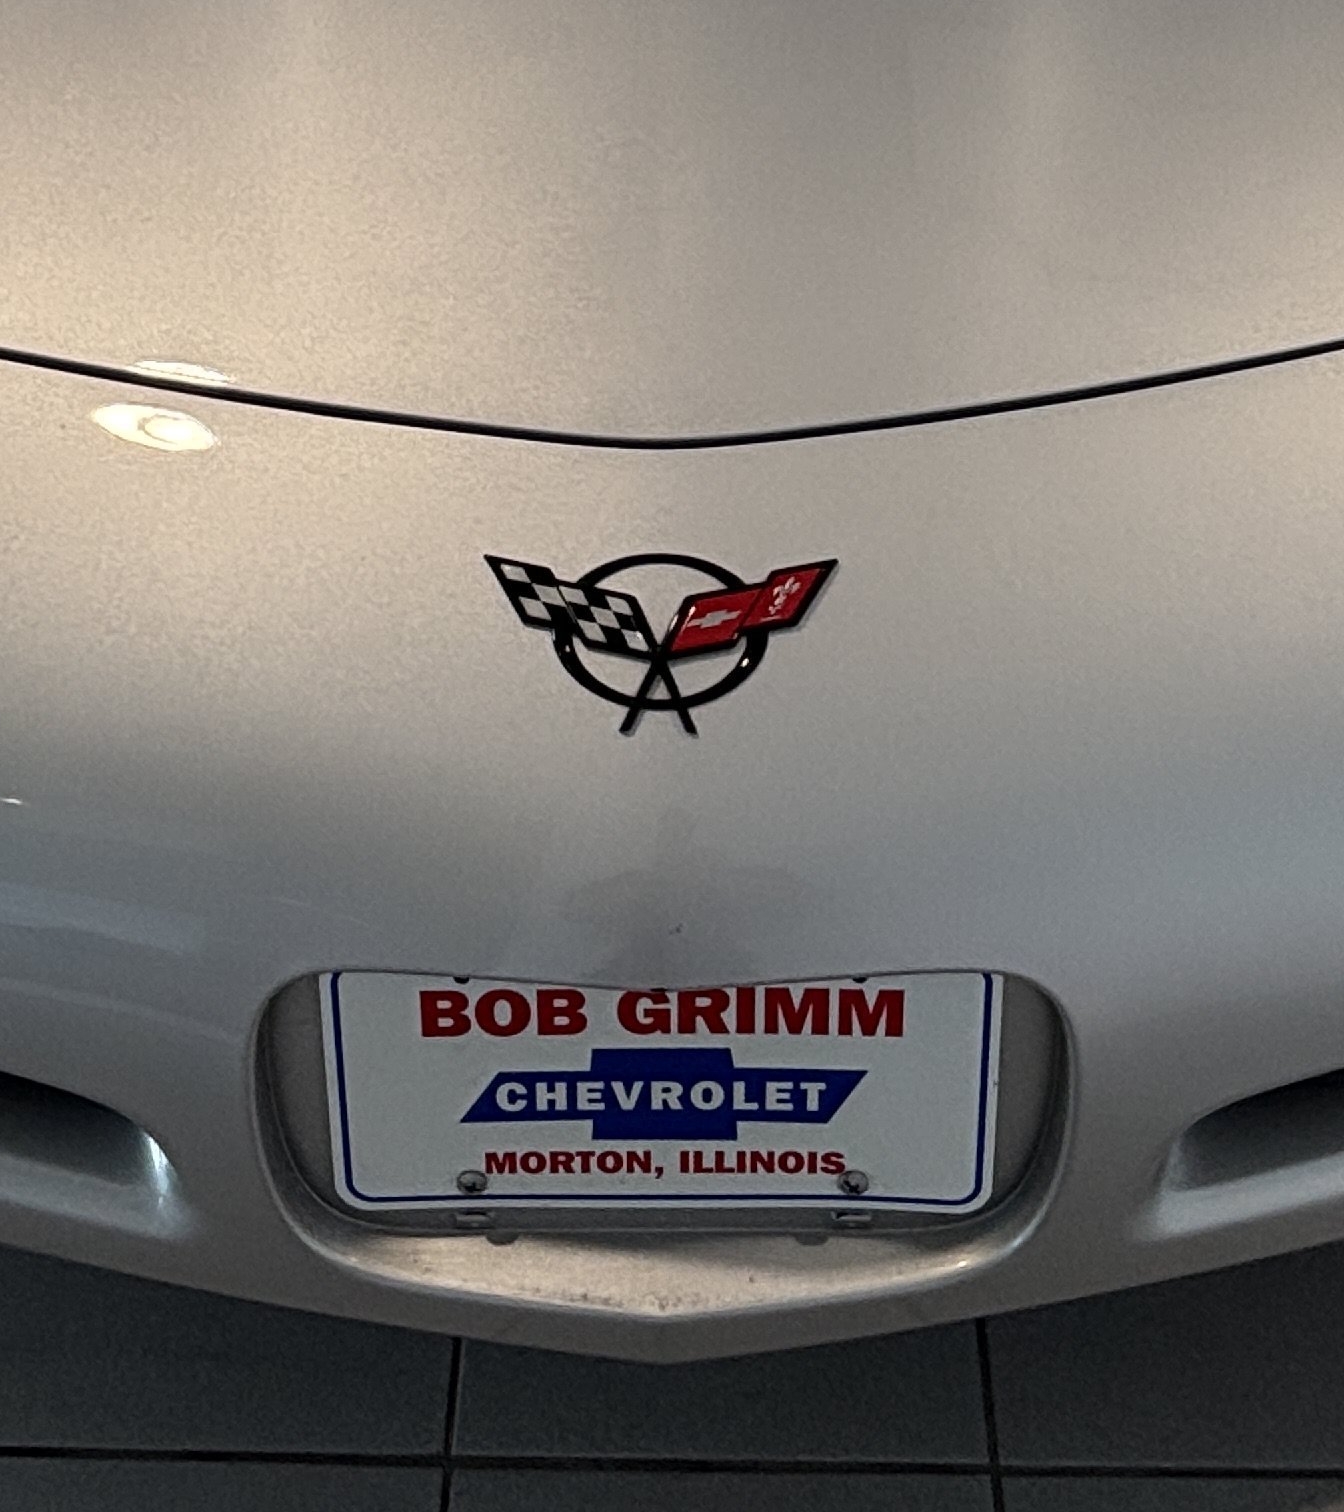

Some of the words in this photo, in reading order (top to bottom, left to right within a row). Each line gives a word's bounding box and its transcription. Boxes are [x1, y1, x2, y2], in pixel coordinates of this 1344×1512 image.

[419, 988, 588, 1038] BOB
[617, 986, 905, 1037] GRIMM
[495, 1080, 827, 1113] CHEVROLET
[484, 1149, 664, 1179] MORTON,
[679, 1150, 846, 1175] ILLINOIS
